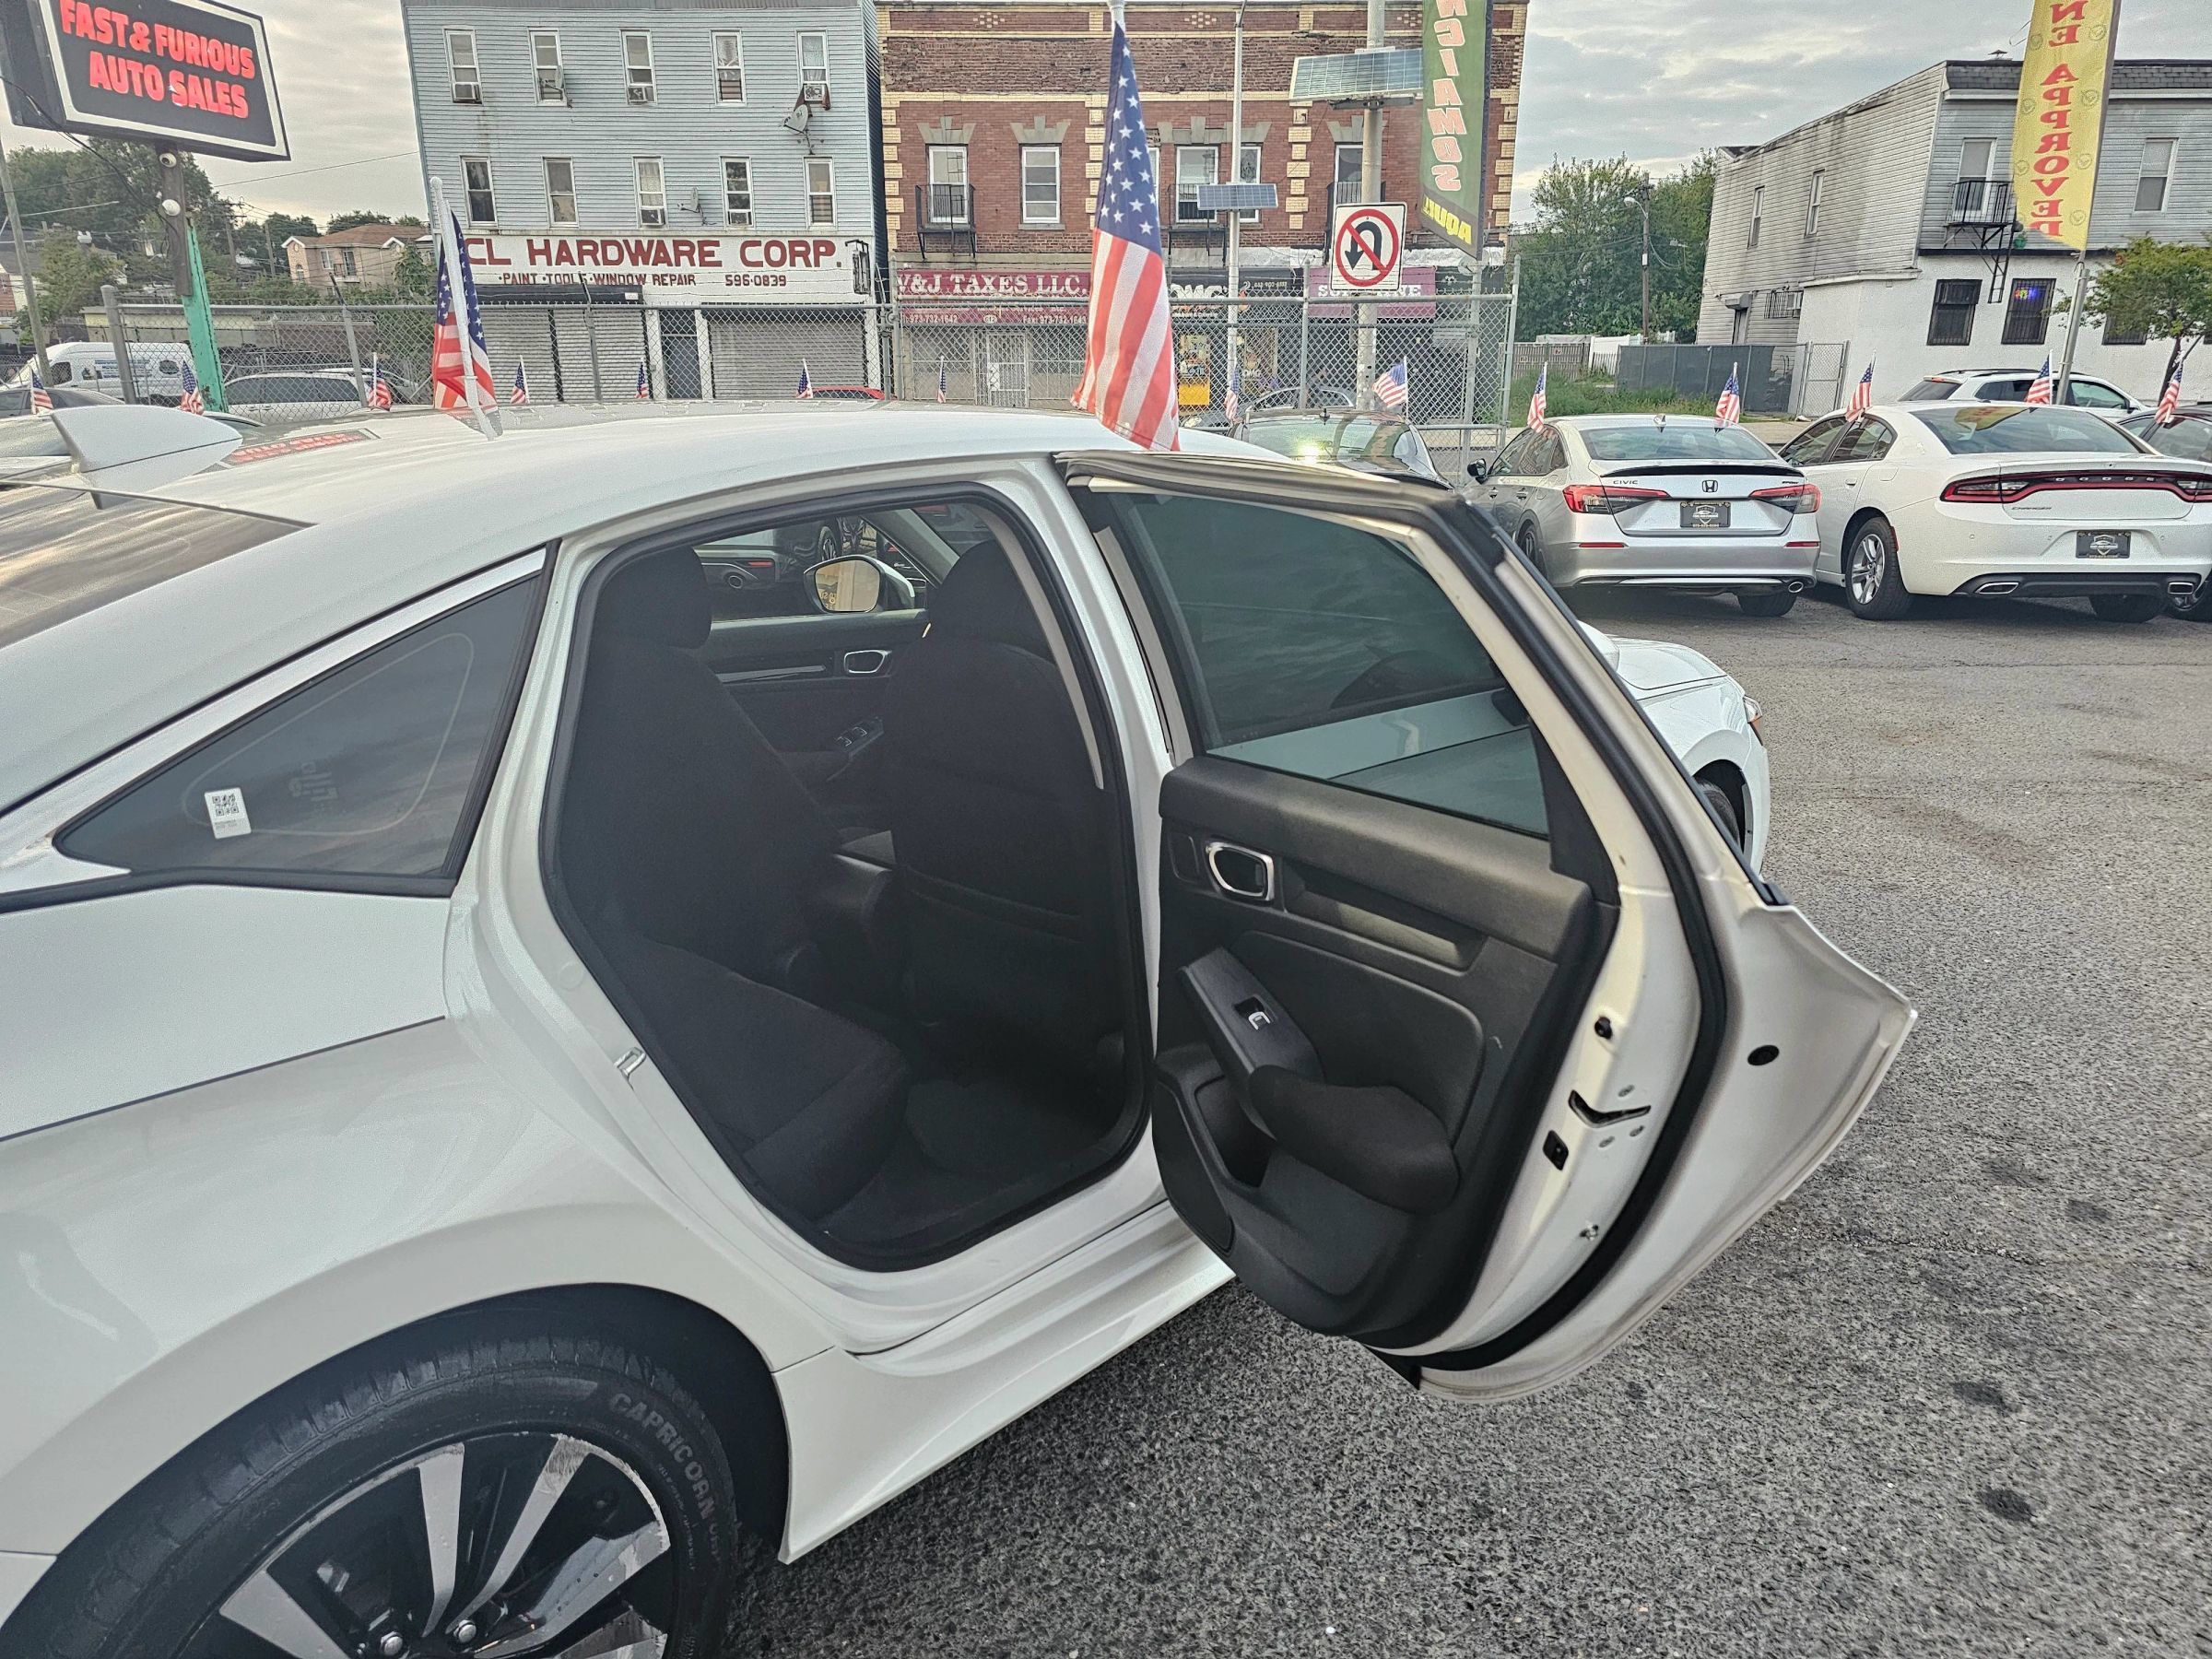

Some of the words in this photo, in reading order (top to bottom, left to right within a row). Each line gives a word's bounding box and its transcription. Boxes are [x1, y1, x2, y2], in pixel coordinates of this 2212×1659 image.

[60, 0, 128, 48] FAST
[129, 22, 151, 53] &
[154, 23, 255, 79] FURIOUS
[89, 51, 164, 101] AUTO
[169, 70, 249, 119] SALES
[526, 239, 723, 267] HARDWARE
[739, 240, 842, 268] CORP.
[503, 273, 538, 285] PAINT
[593, 273, 646, 286] WINDOW
[652, 274, 697, 287] REPAIR
[950, 275, 1029, 294] TAXES
[1035, 275, 1088, 295] LLC.
[610, 1393, 716, 1519] CAPRICORN
